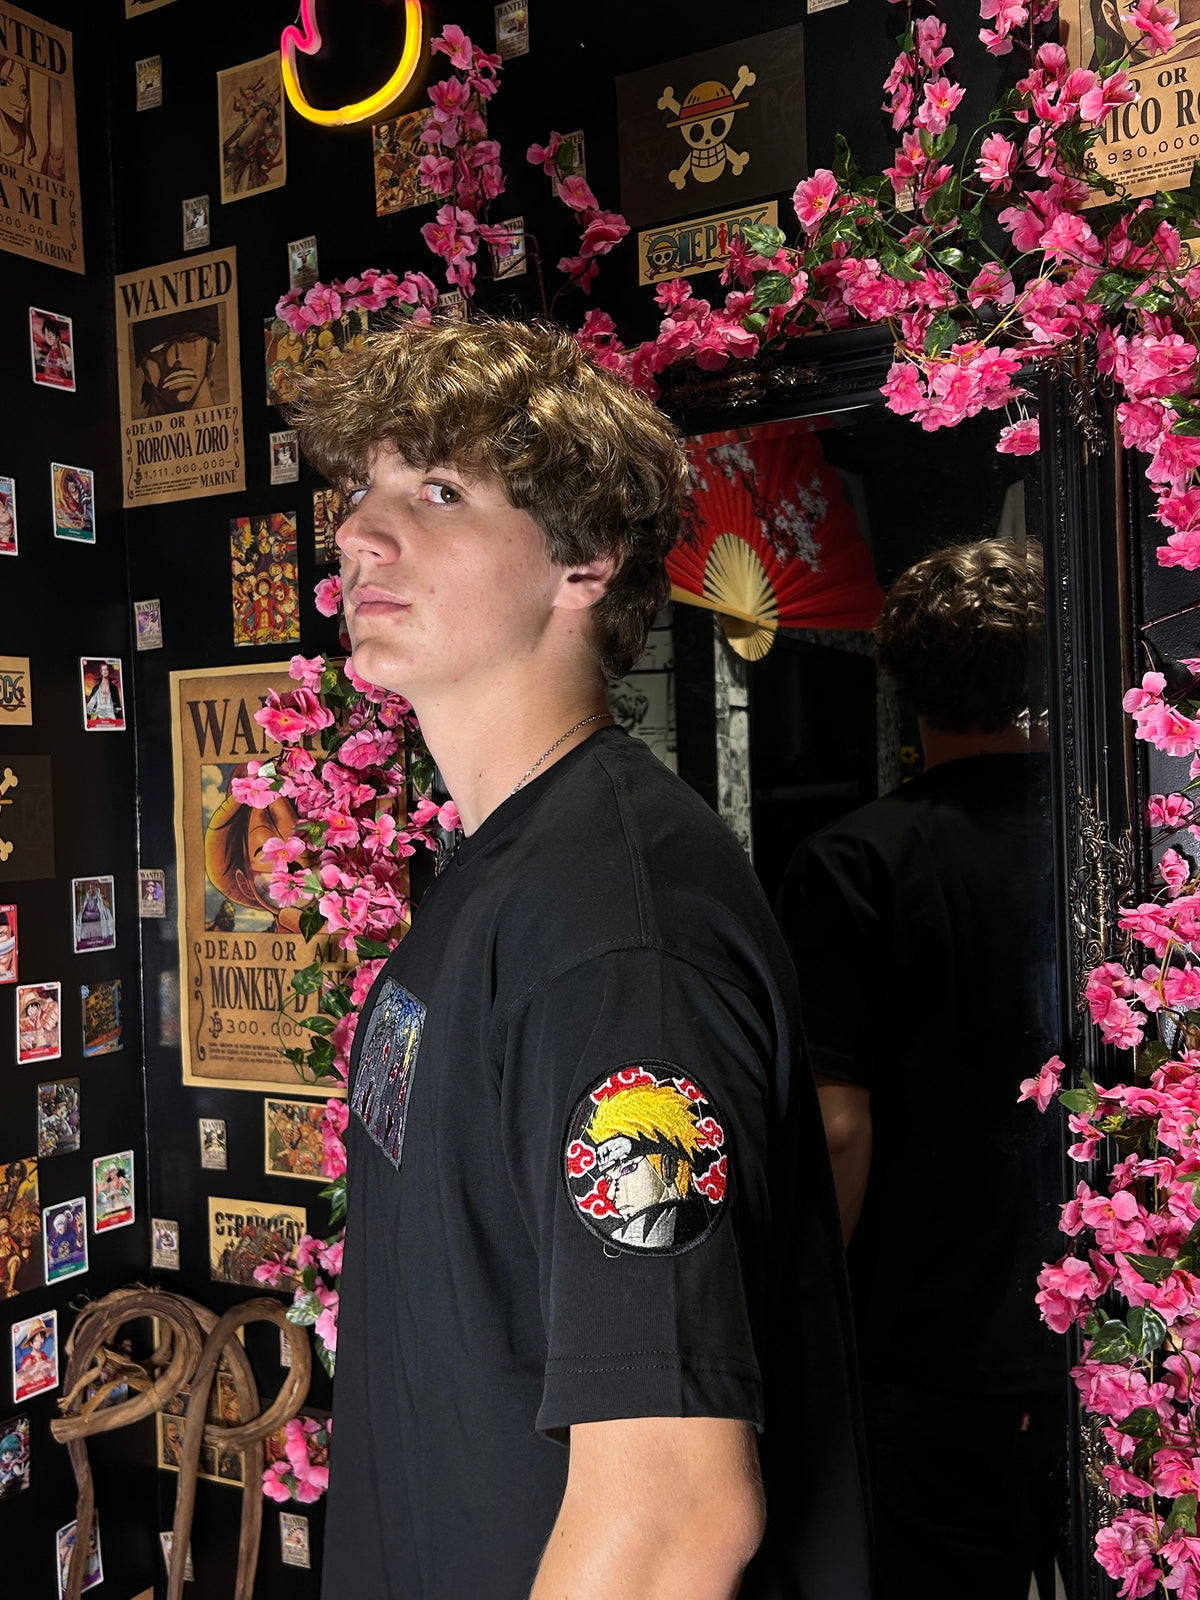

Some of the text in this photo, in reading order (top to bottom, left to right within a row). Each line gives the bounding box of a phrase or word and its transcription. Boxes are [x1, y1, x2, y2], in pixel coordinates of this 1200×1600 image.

[496, 0, 527, 16] WANTED
[1157, 66, 1188, 88] OR
[1175, 88, 1200, 129] R
[0, 162, 69, 200] OR ALIVE
[34, 239, 75, 264] MARINE
[290, 238, 316, 251] WANTED
[119, 259, 233, 319] WANTED
[131, 406, 233, 437] DEAD OR ALIVE
[136, 424, 229, 466] RORONOA ZORO
[200, 469, 238, 489] MARINE
[136, 601, 160, 611] WANTED
[140, 871, 165, 880] WANTED
[205, 939, 350, 963] DEAD OR ALI
